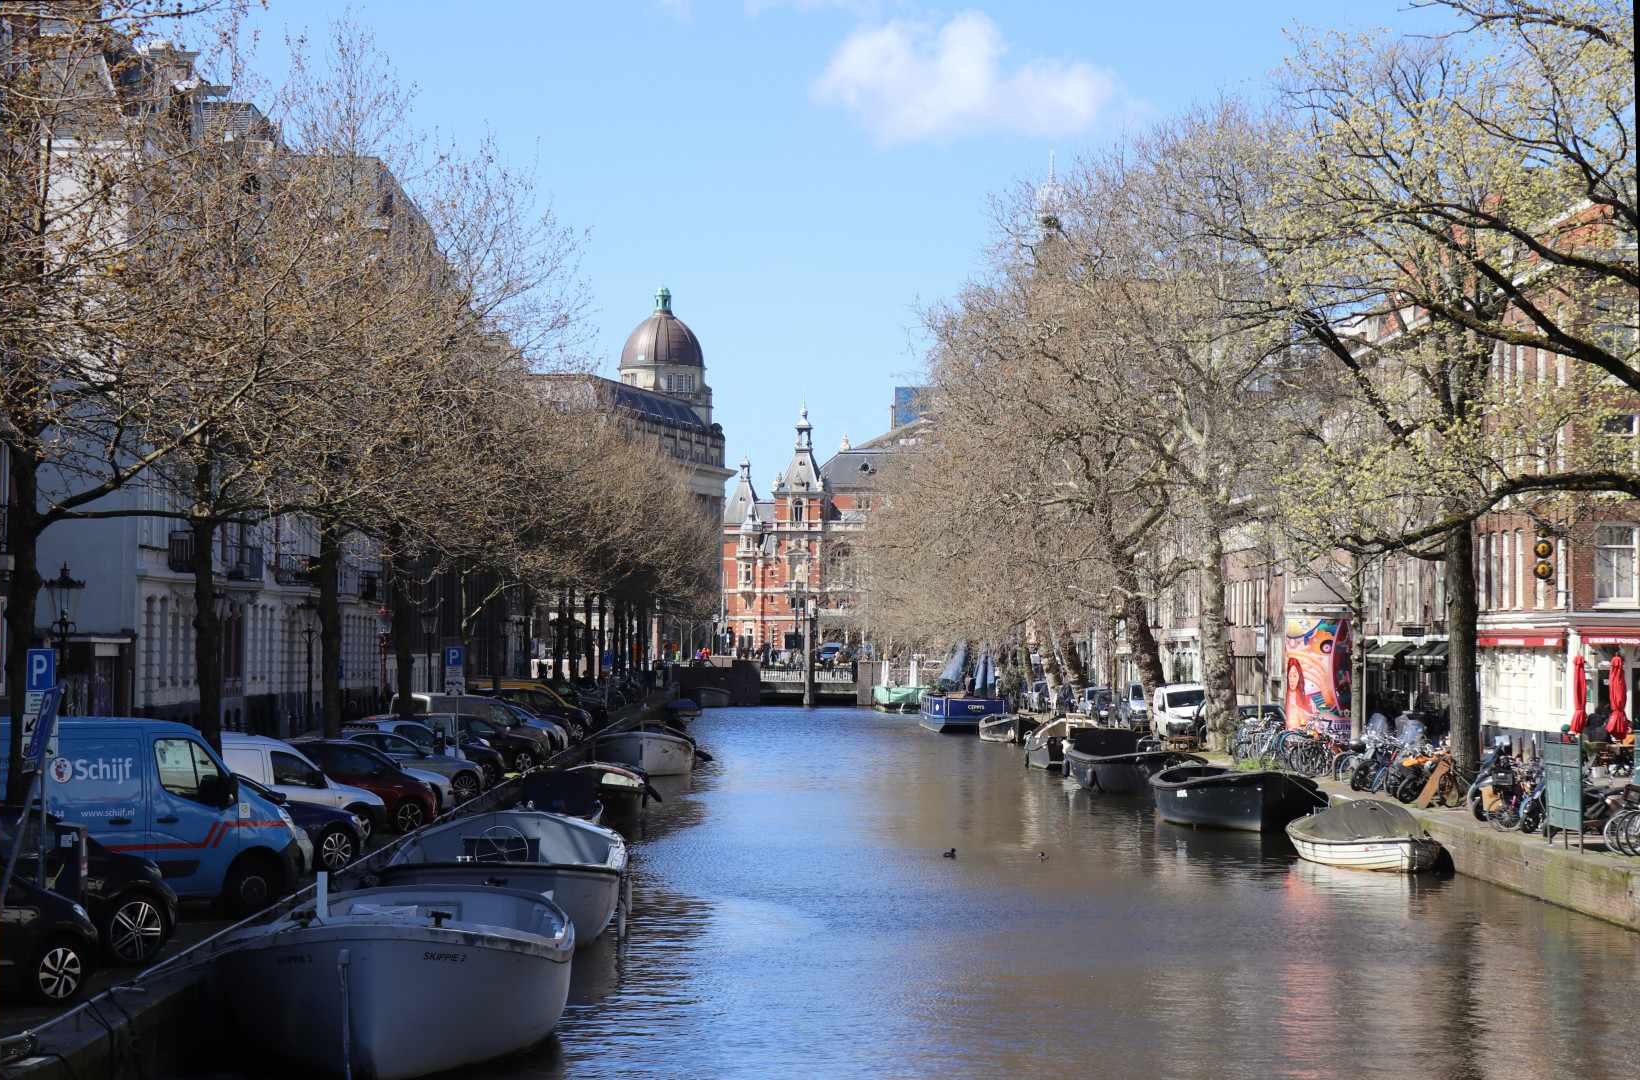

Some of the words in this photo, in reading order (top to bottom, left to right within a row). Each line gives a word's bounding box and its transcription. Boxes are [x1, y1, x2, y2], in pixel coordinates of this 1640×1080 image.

[449, 649, 459, 665] P
[32, 654, 47, 686] P
[74, 757, 133, 785] Schijf
[80, 808, 135, 818] www.schijf.nl
[423, 951, 460, 962] SKIPPIE
[460, 954, 467, 962] 2
